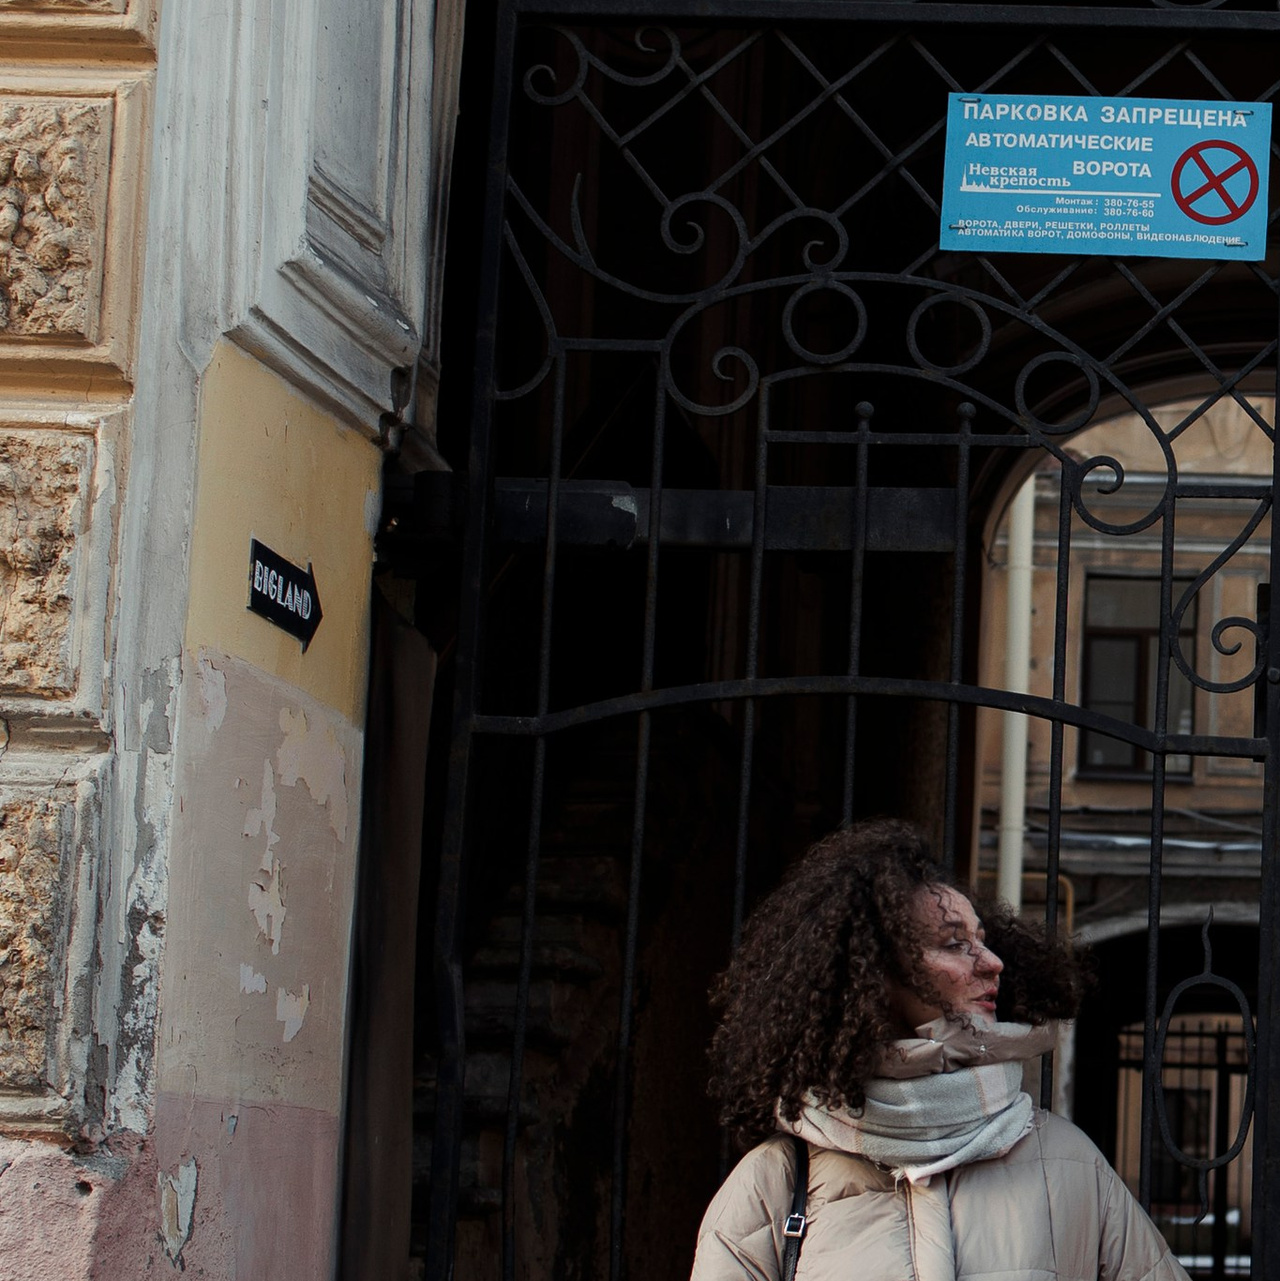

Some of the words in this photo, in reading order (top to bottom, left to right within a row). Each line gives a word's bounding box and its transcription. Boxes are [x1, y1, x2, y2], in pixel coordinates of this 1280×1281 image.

[963, 102, 1089, 122] ПАРКОВКА
[1100, 105, 1247, 129] ЗАПРЕЩЕНА
[965, 132, 1153, 152] АВТОМАТИЧЕСКИЕ
[968, 163, 1038, 177] Невская
[1072, 160, 1152, 178] ВОРОТА
[989, 175, 1072, 188] крепость
[1104, 198, 1155, 209] 380-76-55
[1103, 207, 1154, 218] 380-76-60
[254, 559, 312, 620] BIGLAND
